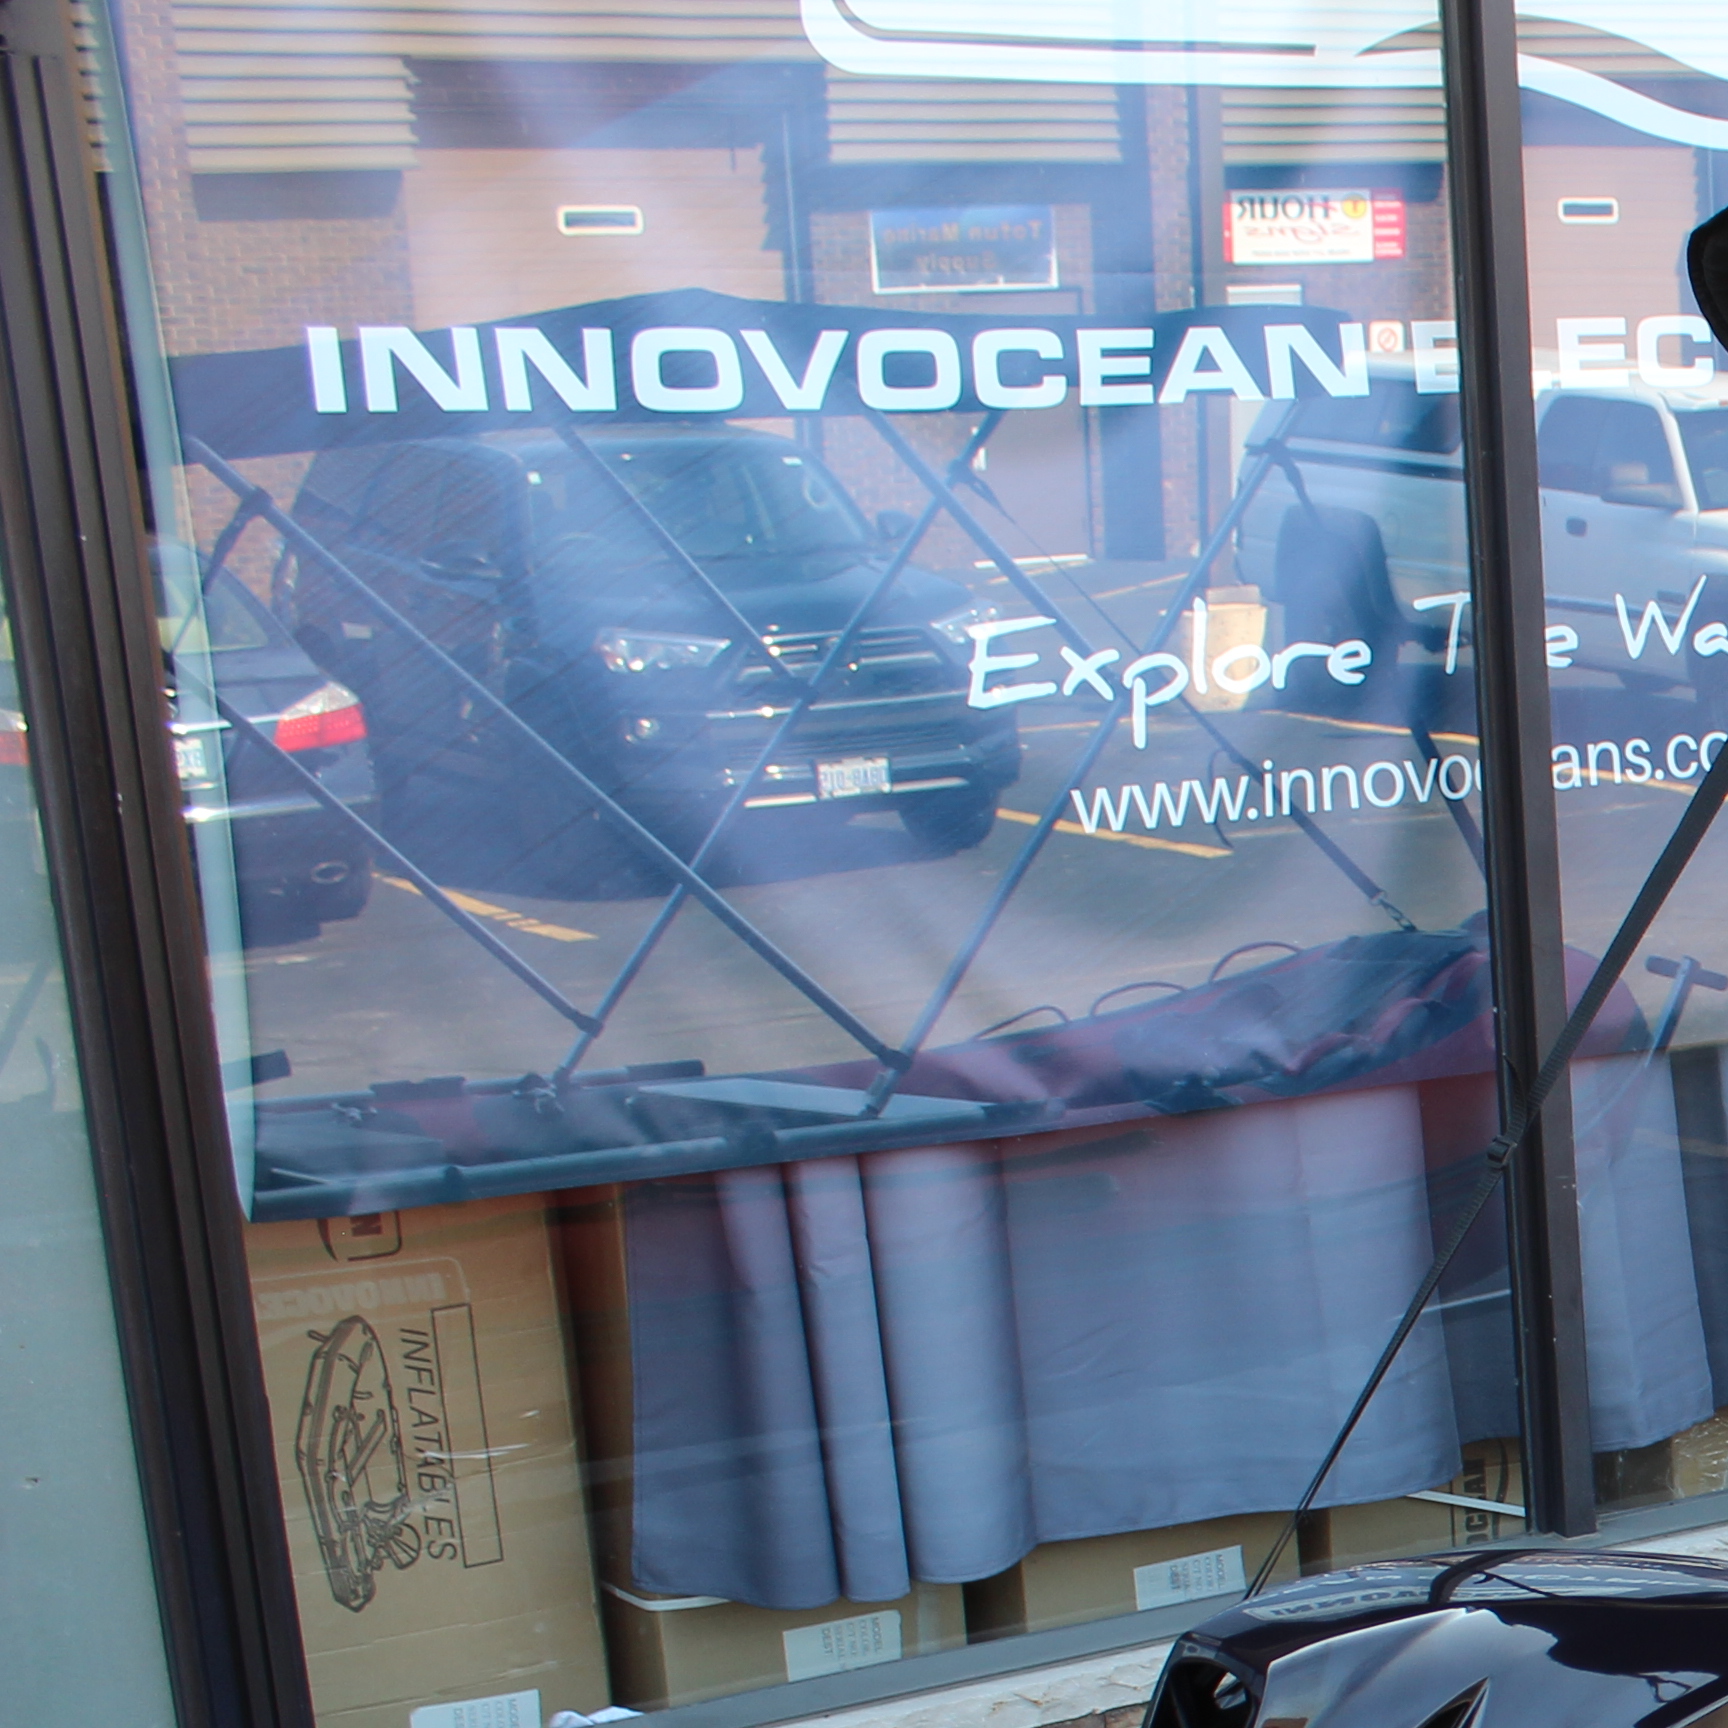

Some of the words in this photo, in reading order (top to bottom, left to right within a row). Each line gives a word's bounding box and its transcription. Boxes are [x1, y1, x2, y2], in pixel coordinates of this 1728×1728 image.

[307, 321, 1370, 415] INNOVOCEAN
[966, 597, 1373, 750] Explore
[1413, 590, 1578, 676] Te
[399, 1326, 459, 1562] INFLATABLES
